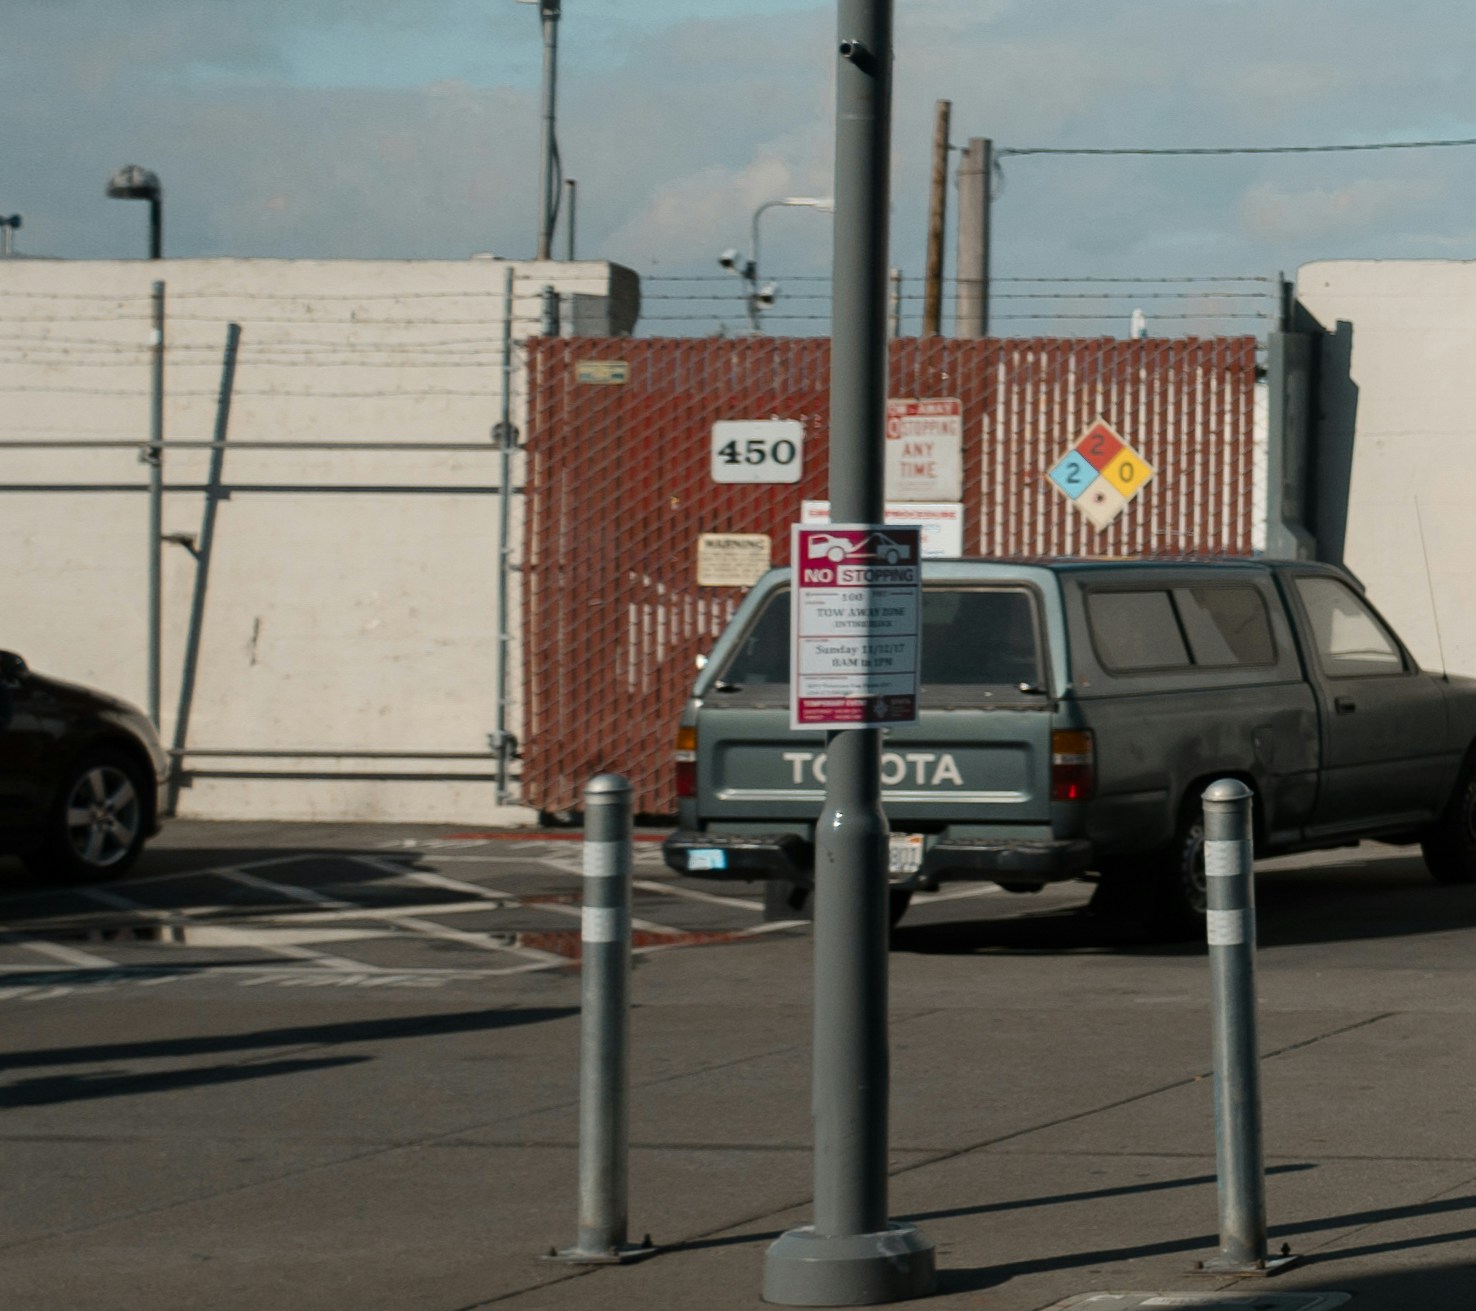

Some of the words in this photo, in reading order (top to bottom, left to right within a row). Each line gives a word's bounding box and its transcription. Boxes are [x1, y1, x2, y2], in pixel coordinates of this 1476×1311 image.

[718, 439, 796, 465] 450
[902, 442, 934, 457] ANY
[1089, 434, 1105, 456] 2
[900, 462, 938, 478] TIME
[1066, 462, 1082, 484] 2
[1118, 461, 1134, 484] 0
[804, 568, 834, 583] NO
[842, 568, 914, 583] STOPPING
[816, 608, 844, 617] TOW
[815, 645, 858, 655] Sunday
